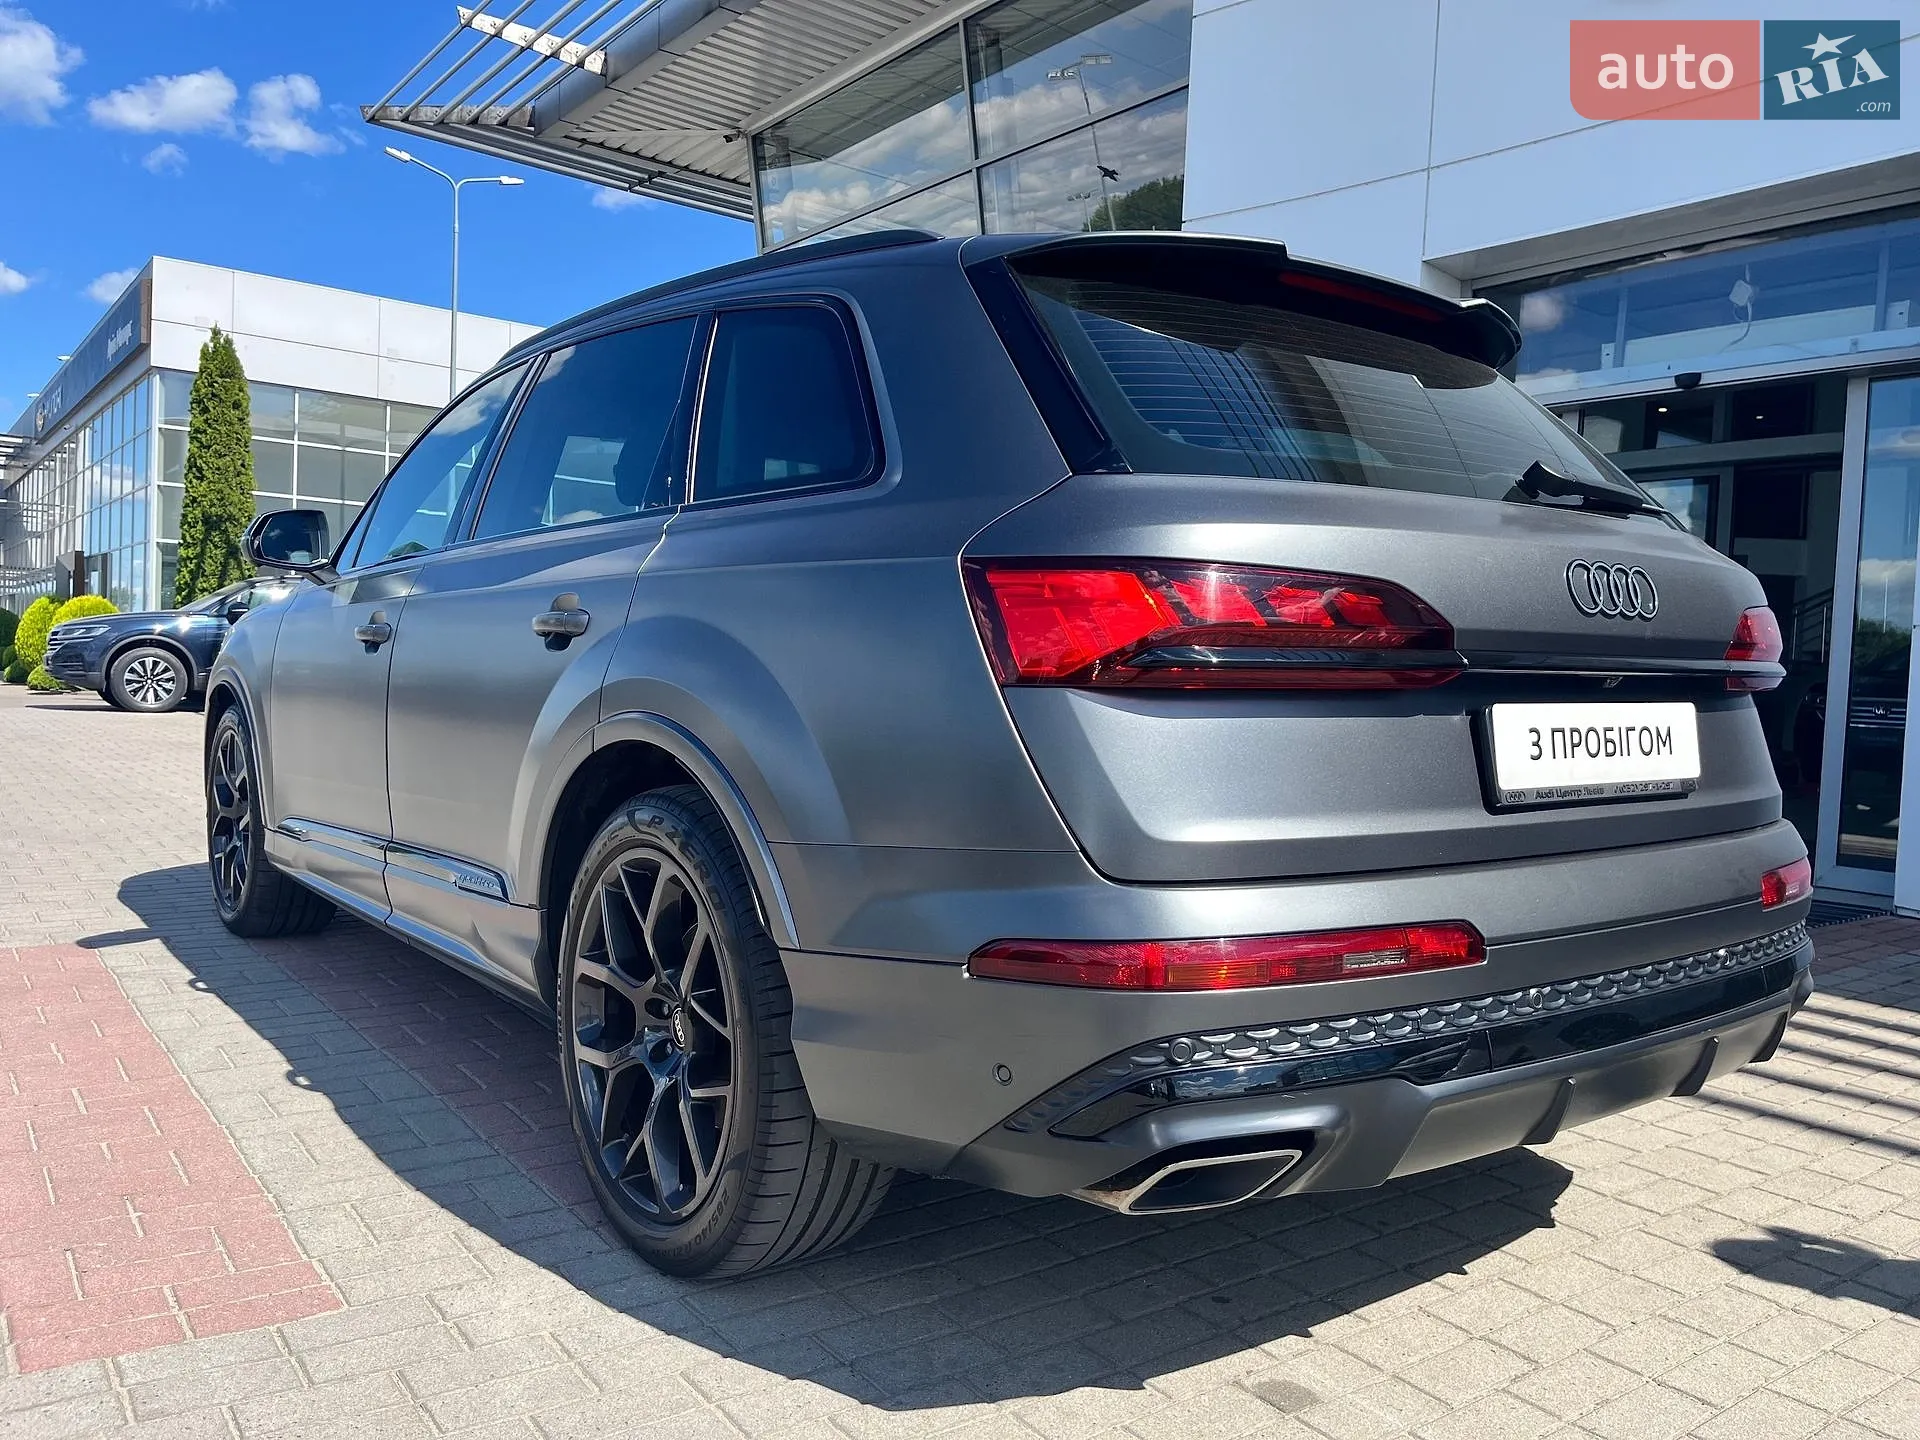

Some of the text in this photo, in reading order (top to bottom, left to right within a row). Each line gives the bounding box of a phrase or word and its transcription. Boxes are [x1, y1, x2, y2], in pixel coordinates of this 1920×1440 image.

[1550, 726, 1673, 759] ПРОБІГОМ
[1534, 789, 1555, 800] Audi
[647, 814, 665, 828] P
